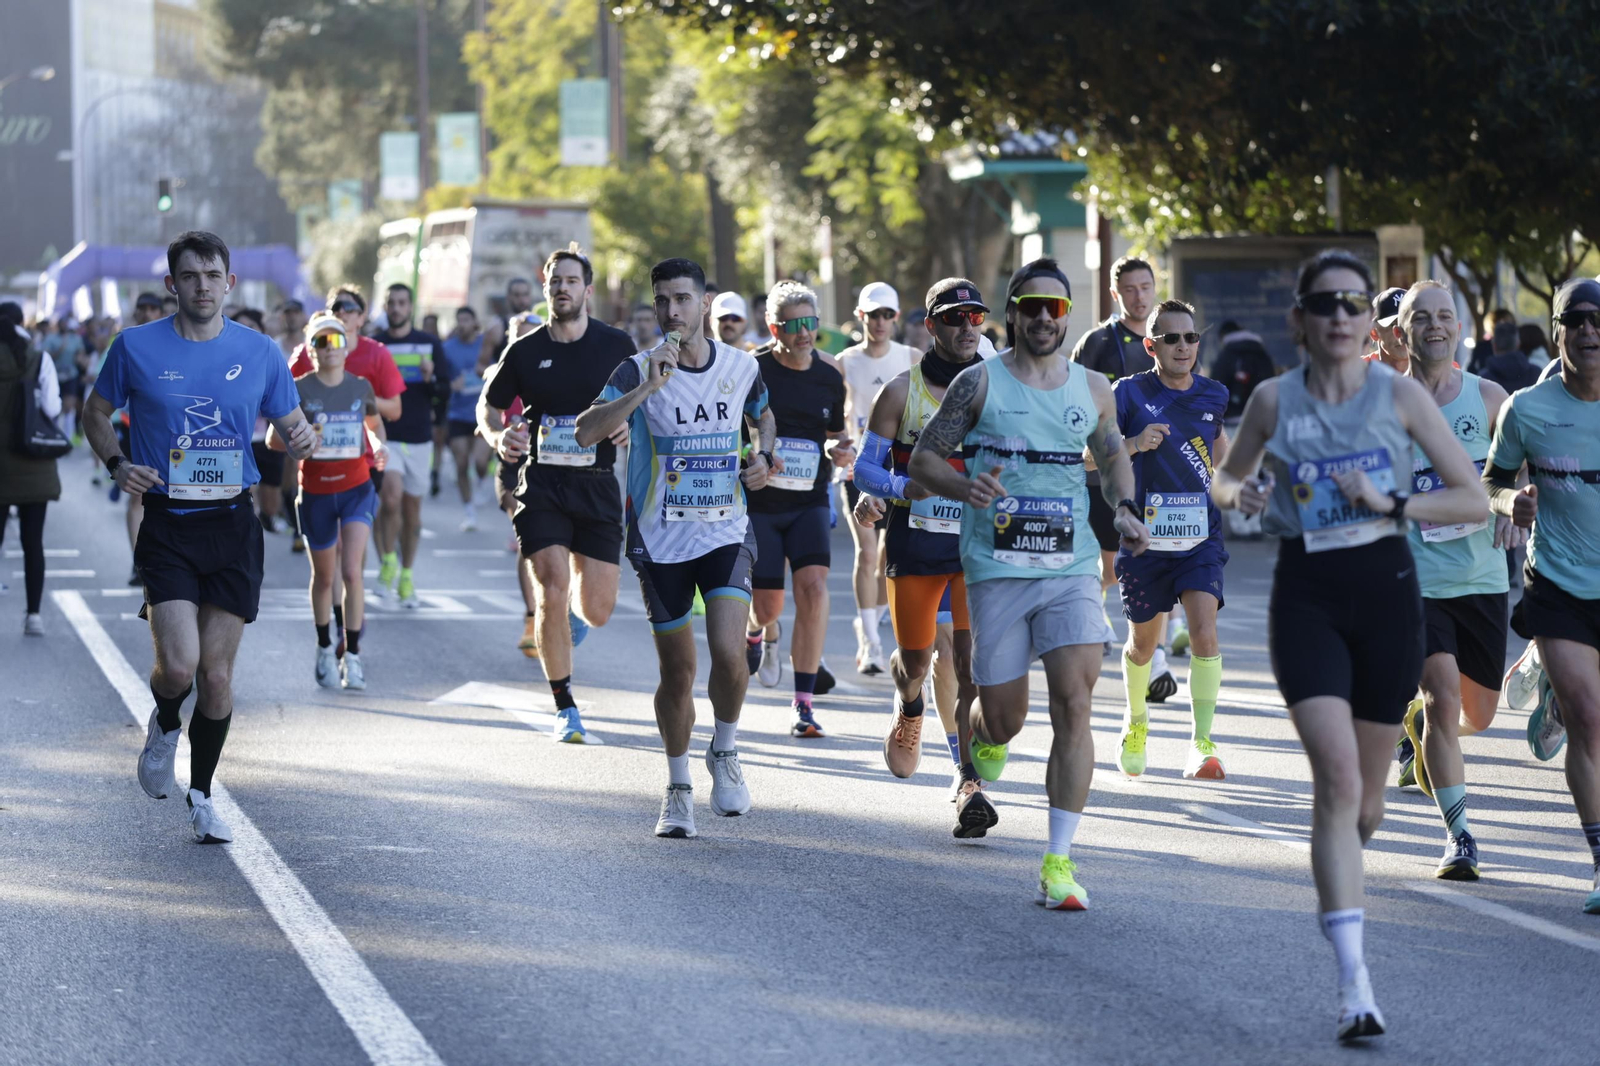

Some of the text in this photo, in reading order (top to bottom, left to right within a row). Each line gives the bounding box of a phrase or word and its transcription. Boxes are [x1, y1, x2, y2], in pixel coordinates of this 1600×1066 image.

[675, 402, 729, 425] LAR
[196, 438, 235, 447] ZURICH
[673, 436, 732, 451] RUNNING
[785, 441, 815, 450] ZURICH
[196, 457, 217, 466] 4771
[692, 460, 729, 469] ZURICH
[1323, 454, 1379, 476] ZURICH
[189, 470, 224, 483] JOSH
[778, 466, 812, 478] ANOLO
[693, 479, 713, 488] 5351
[667, 494, 733, 506] ALEX MARTIN
[1167, 496, 1200, 505] ZURICH
[933, 504, 961, 519] VITO
[1024, 501, 1064, 511] ZURICH
[1168, 513, 1186, 521] 6742
[1023, 522, 1047, 533] 4007
[1152, 524, 1201, 536] JUANITO
[1012, 535, 1057, 551] JAIME
